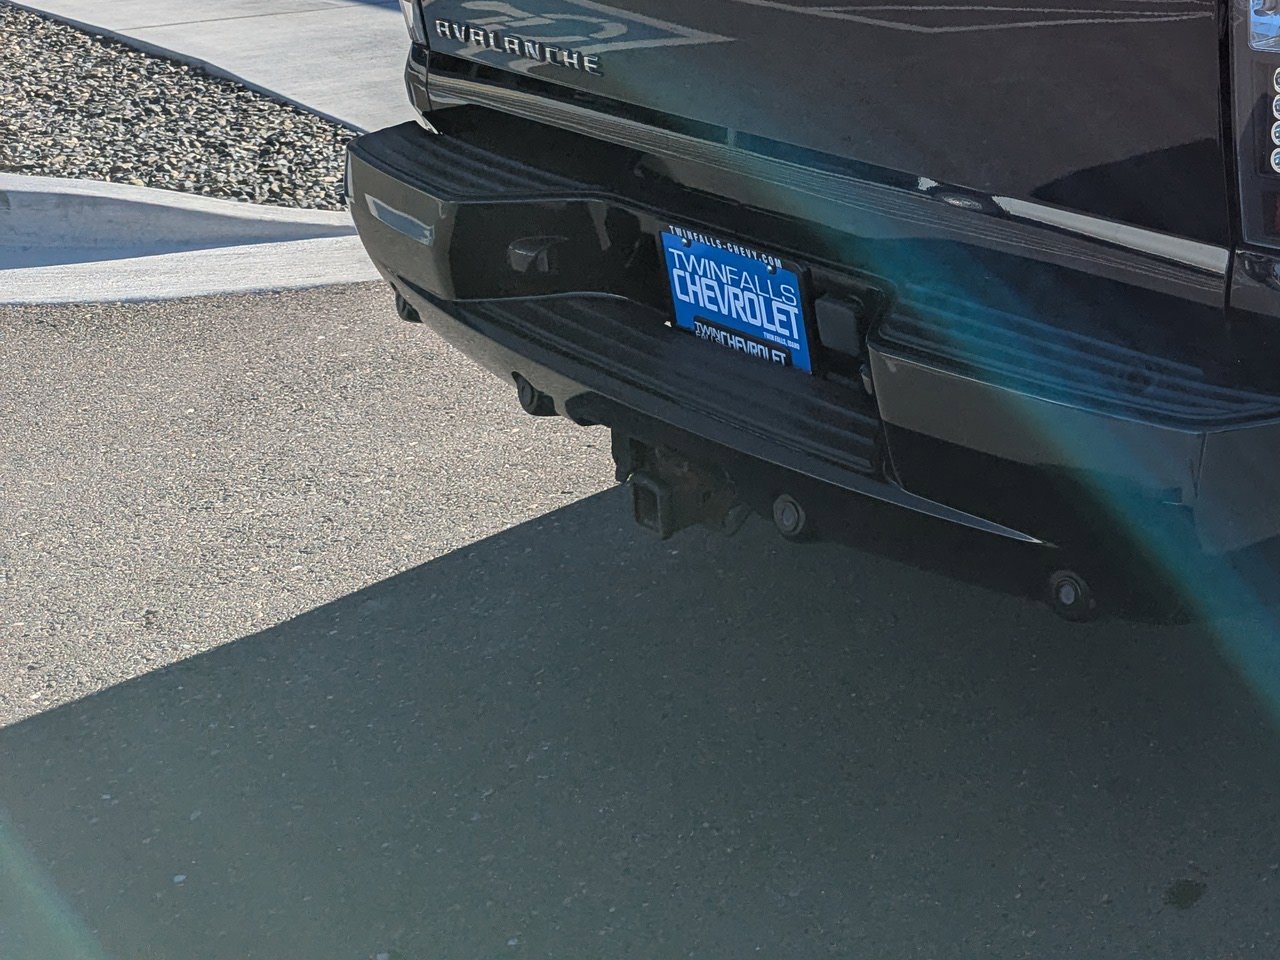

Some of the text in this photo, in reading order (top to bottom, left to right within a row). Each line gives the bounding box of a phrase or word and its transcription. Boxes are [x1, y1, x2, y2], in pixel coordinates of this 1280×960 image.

[435, 19, 601, 76] AVALANCHE
[669, 225, 782, 269] TWINFALLS-CHEVY.COM
[668, 248, 797, 306] TWINFALLS
[672, 268, 799, 340] CHEVROLET
